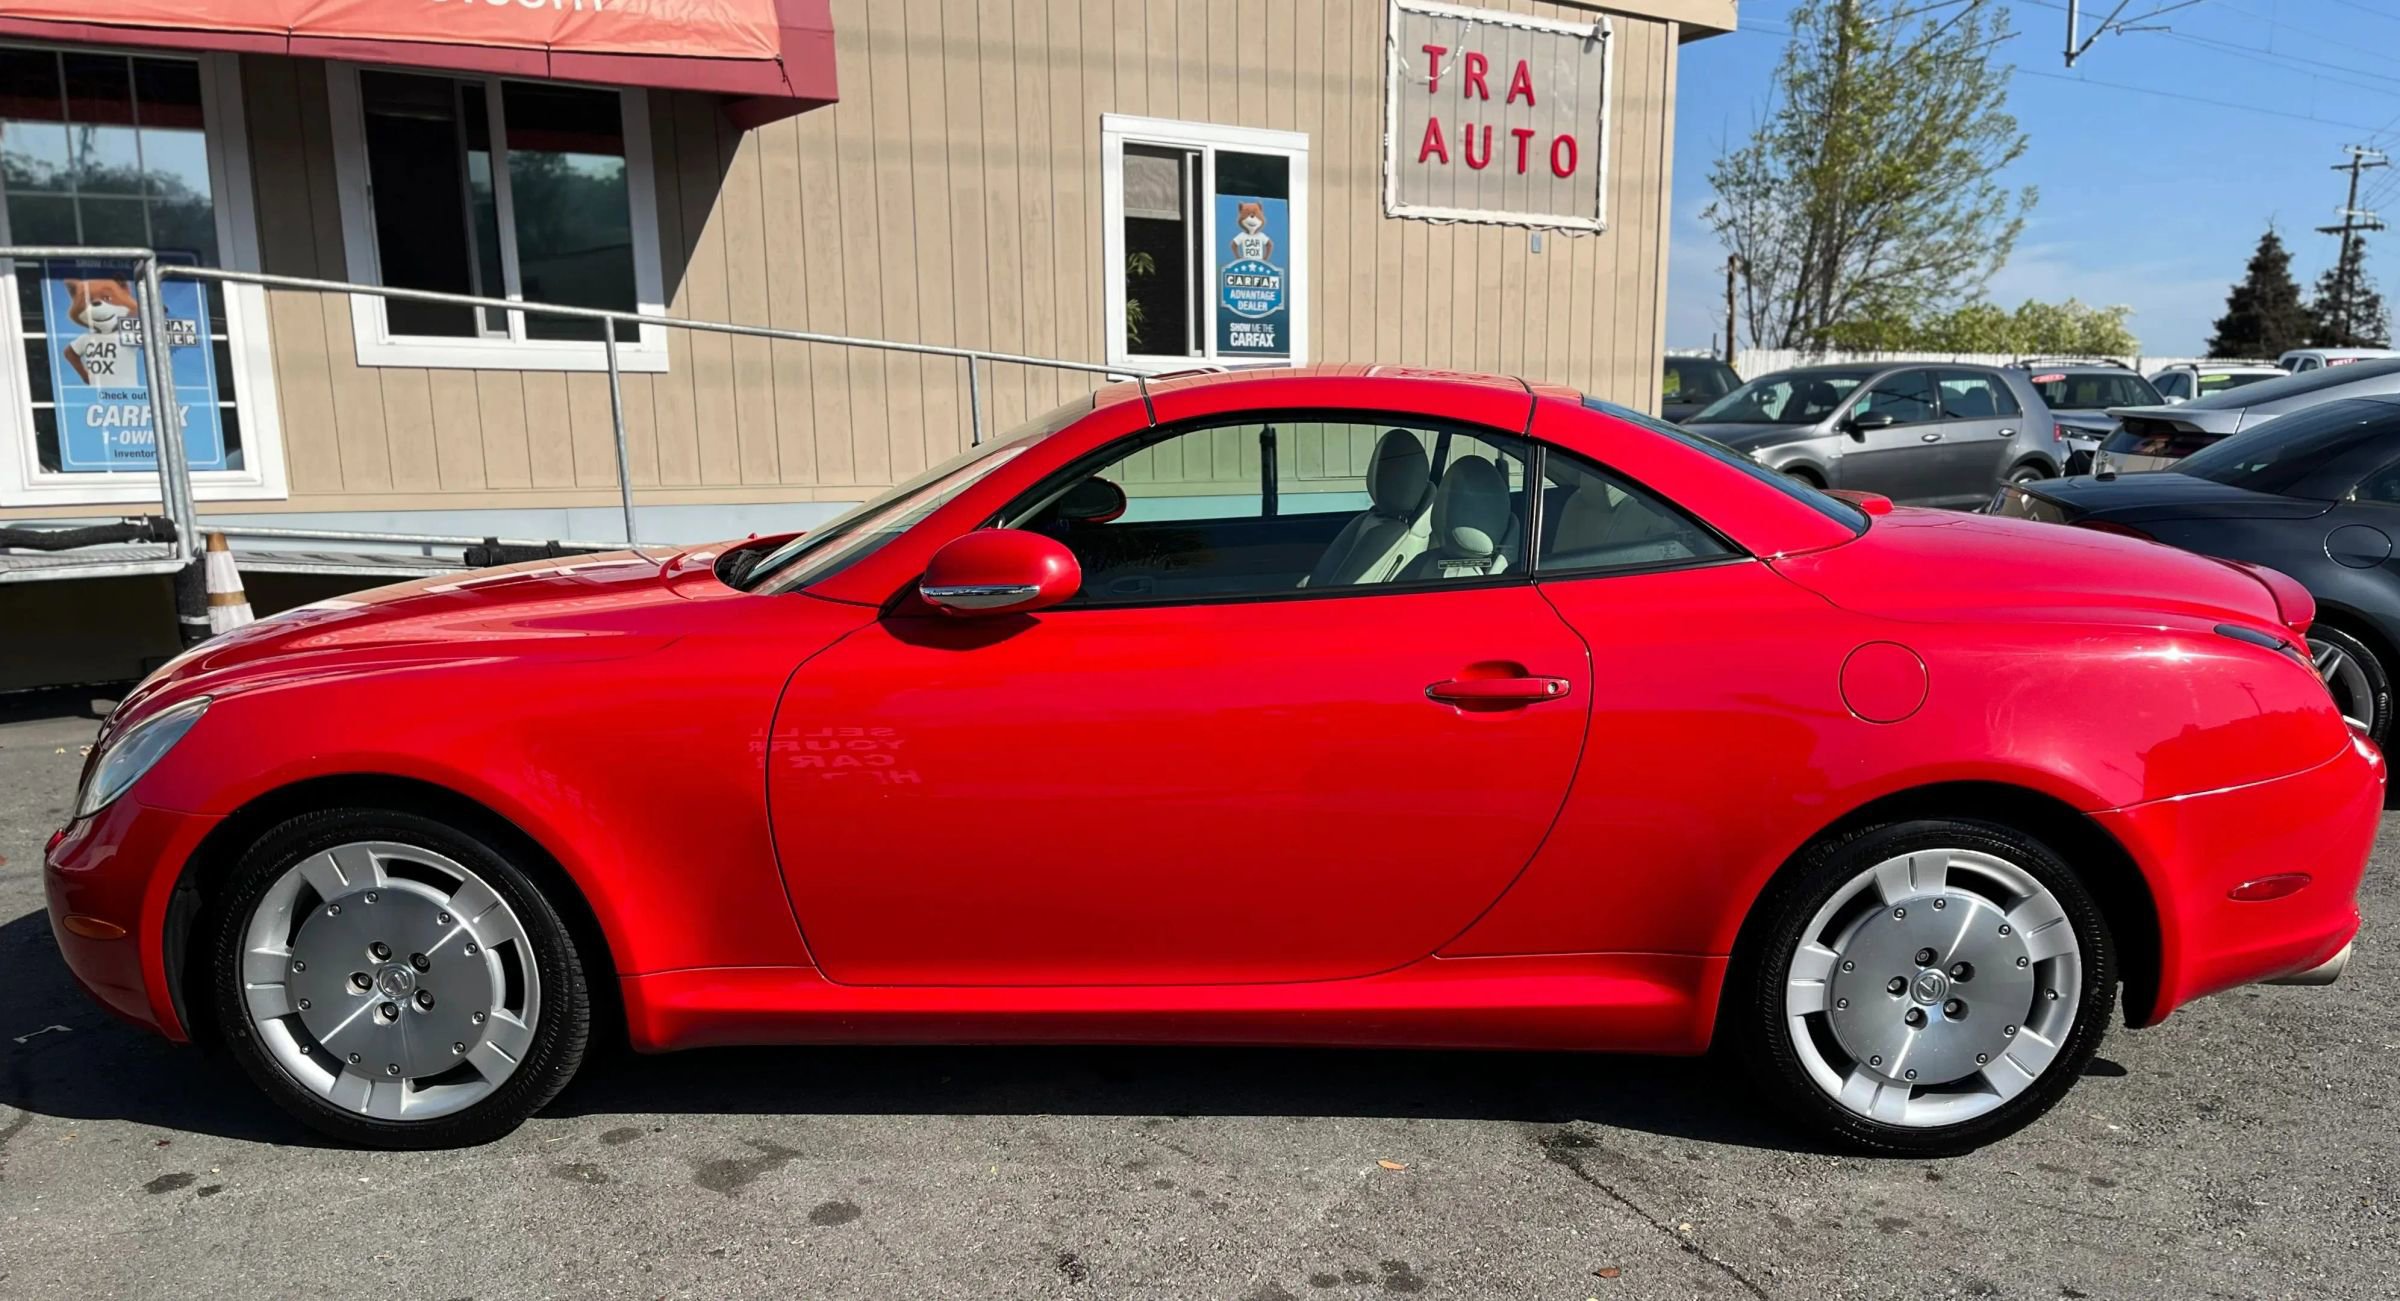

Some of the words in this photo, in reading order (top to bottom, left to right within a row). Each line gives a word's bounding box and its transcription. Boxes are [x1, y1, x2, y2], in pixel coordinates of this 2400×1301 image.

[1422, 44, 1536, 107] TRA
[1418, 117, 1578, 178] AUTO
[1245, 239, 1260, 247] CAR
[1245, 248, 1260, 256] FOX
[1227, 275, 1279, 289] CARFAX
[1230, 289, 1276, 300] ADVANTAGE
[1237, 300, 1268, 310] DEALER
[122, 320, 195, 333] CAAX
[1230, 322, 1250, 332] SHOW
[1251, 323, 1261, 333] ME
[1262, 323, 1275, 333] THE
[1230, 332, 1275, 347] CARFAX
[85, 342, 117, 358] CAR
[99, 391, 128, 400] Check
[131, 392, 147, 400] out
[86, 404, 189, 427] CARFX
[102, 430, 156, 445] 1-OWN
[114, 449, 157, 458] Inventor
